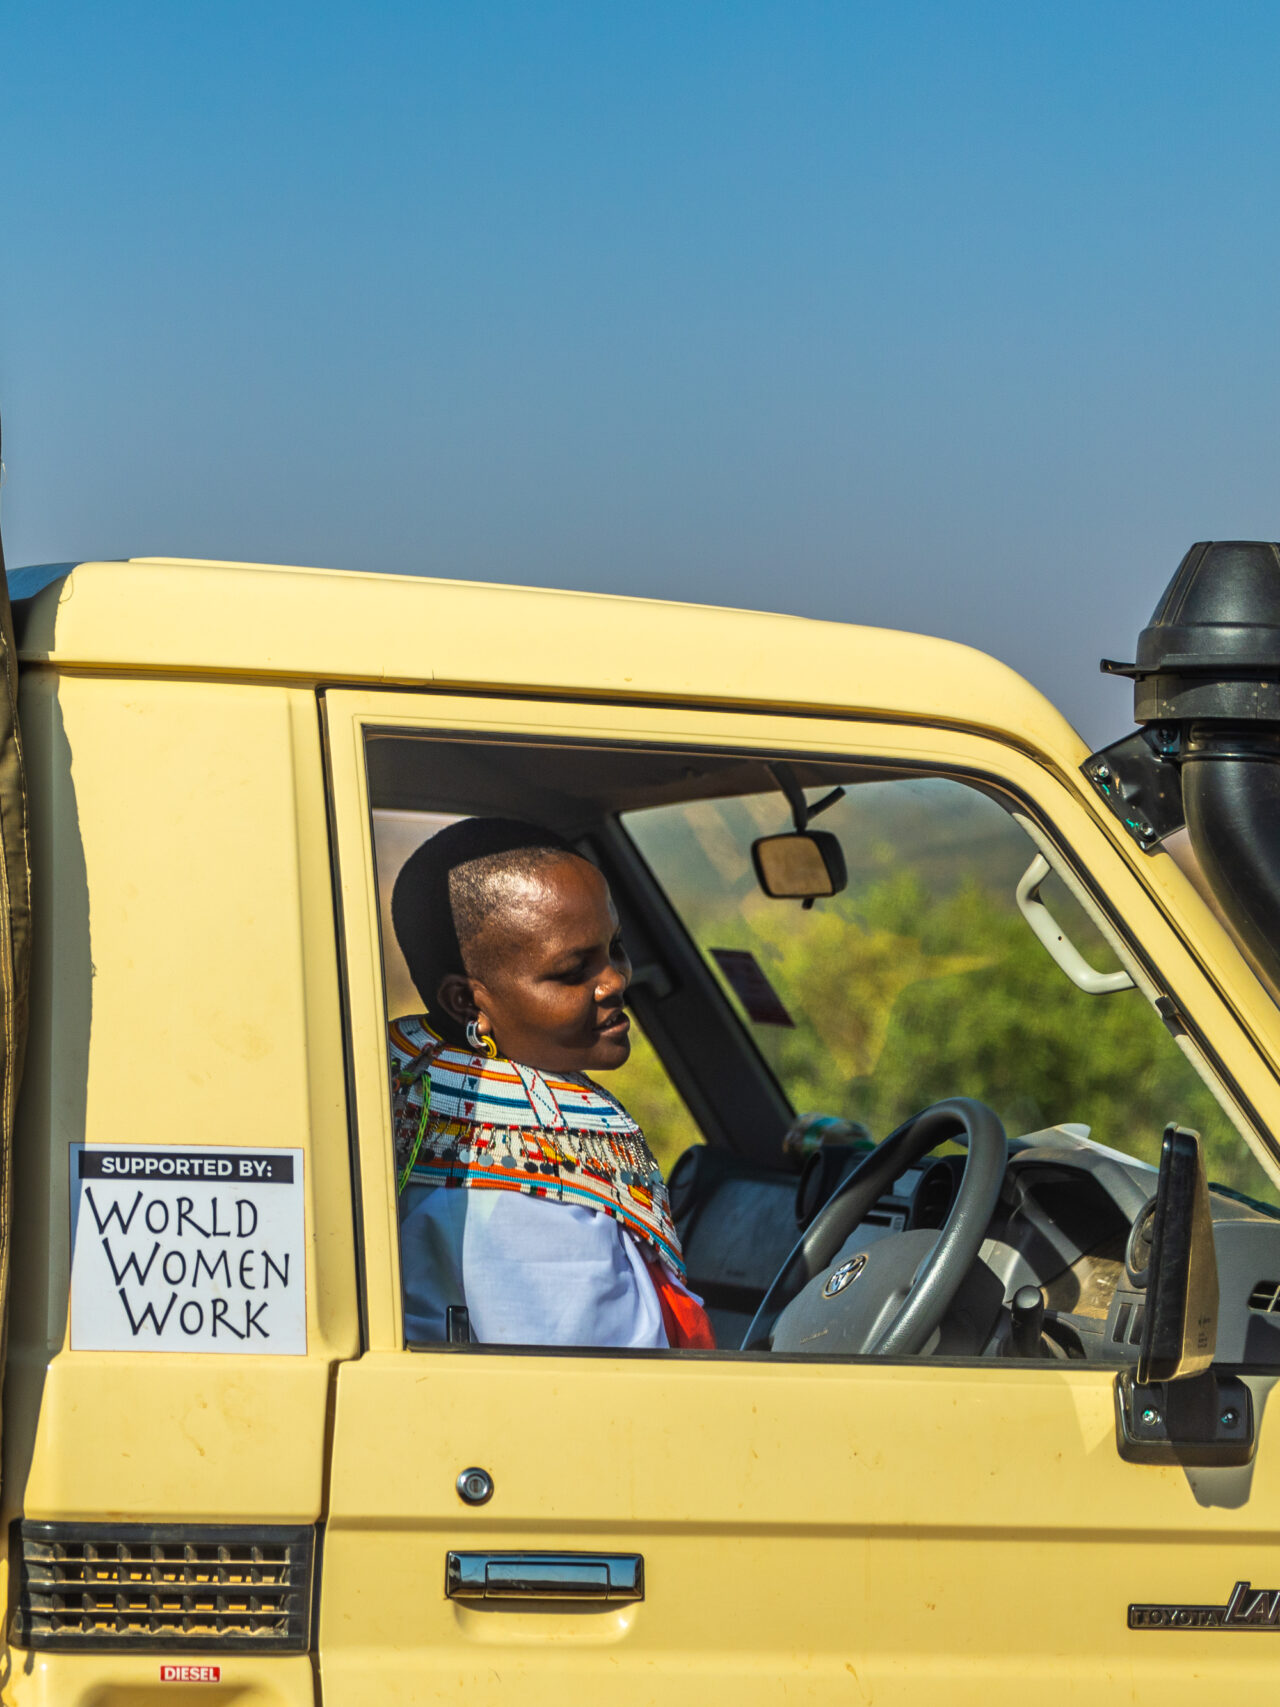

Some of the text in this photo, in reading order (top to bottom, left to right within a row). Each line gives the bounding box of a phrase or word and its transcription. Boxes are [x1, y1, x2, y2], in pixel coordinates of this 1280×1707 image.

[101, 1156, 273, 1177] SUPPORTED BY:
[85, 1186, 258, 1238] WORLD
[102, 1237, 290, 1290] WOMEN
[118, 1287, 270, 1340] WORK
[1133, 1609, 1219, 1626] TOYOTA
[164, 1667, 218, 1681] DIESEL
